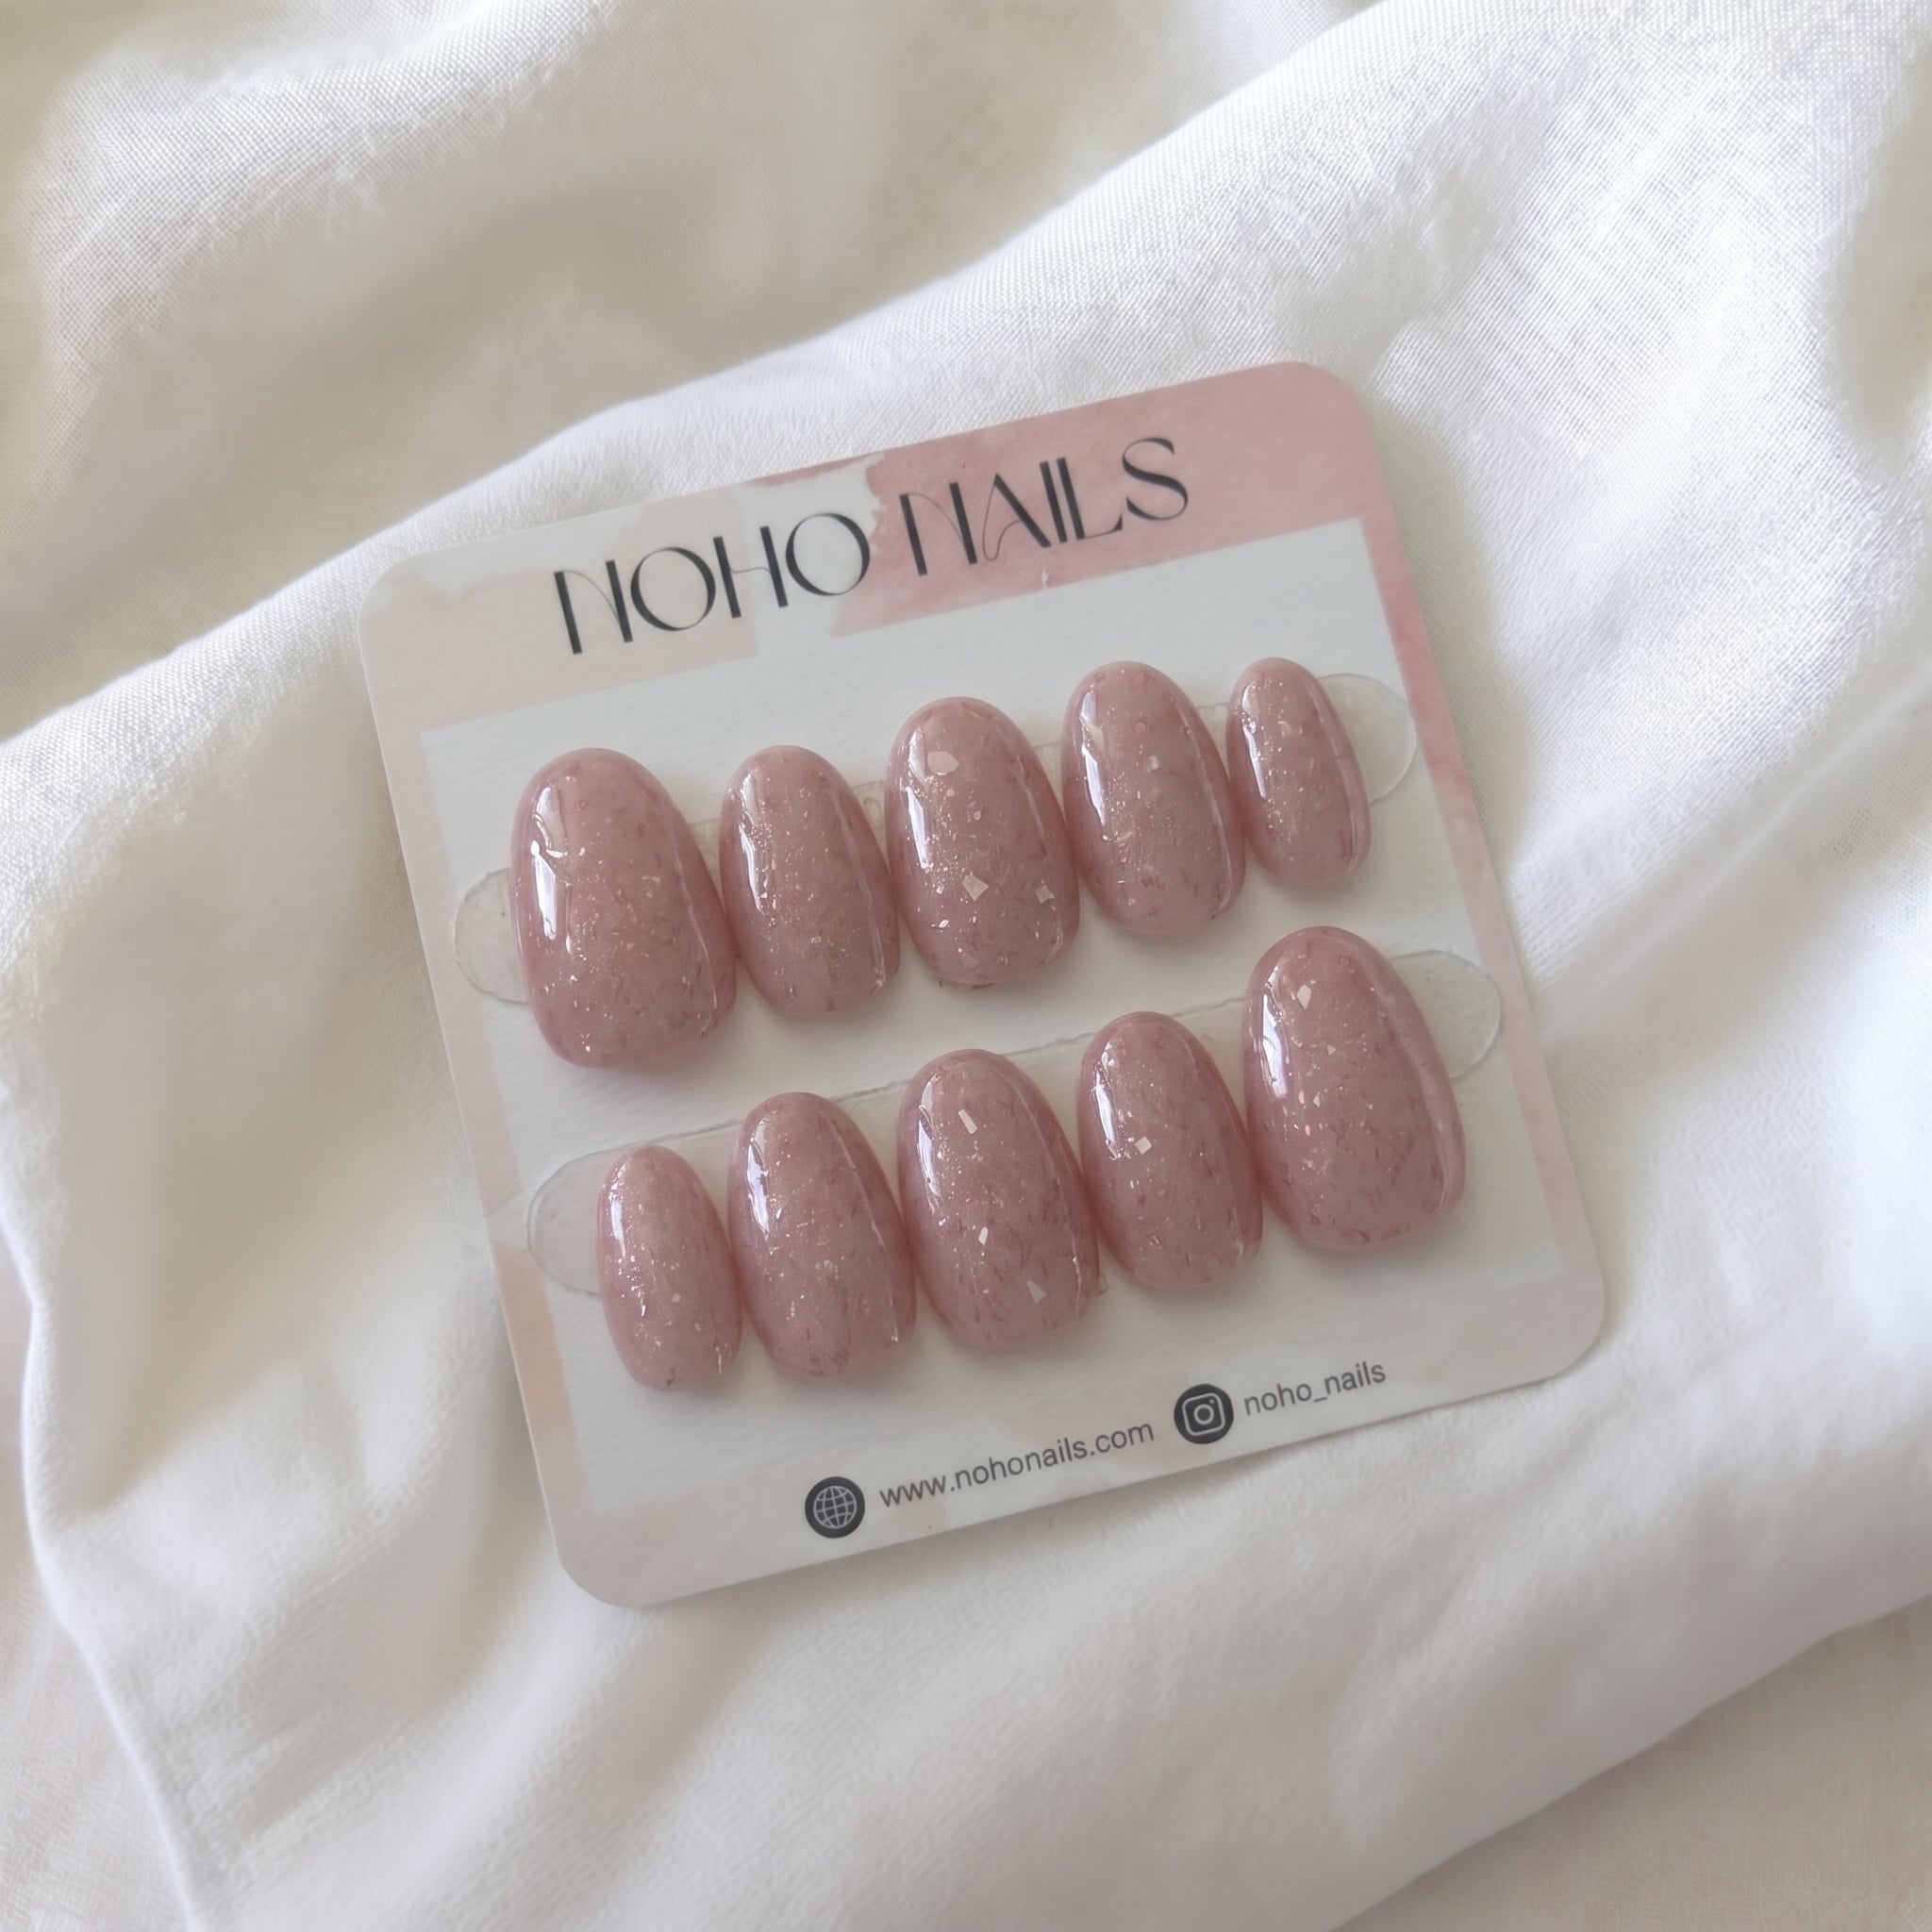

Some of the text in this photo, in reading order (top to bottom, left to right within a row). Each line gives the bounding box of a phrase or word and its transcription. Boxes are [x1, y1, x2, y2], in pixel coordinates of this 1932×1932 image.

[554, 436, 1189, 655] NOHO NAILS
[1244, 1361, 1386, 1416] noho_nails
[879, 1423, 1155, 1507] www.nohonails.com
